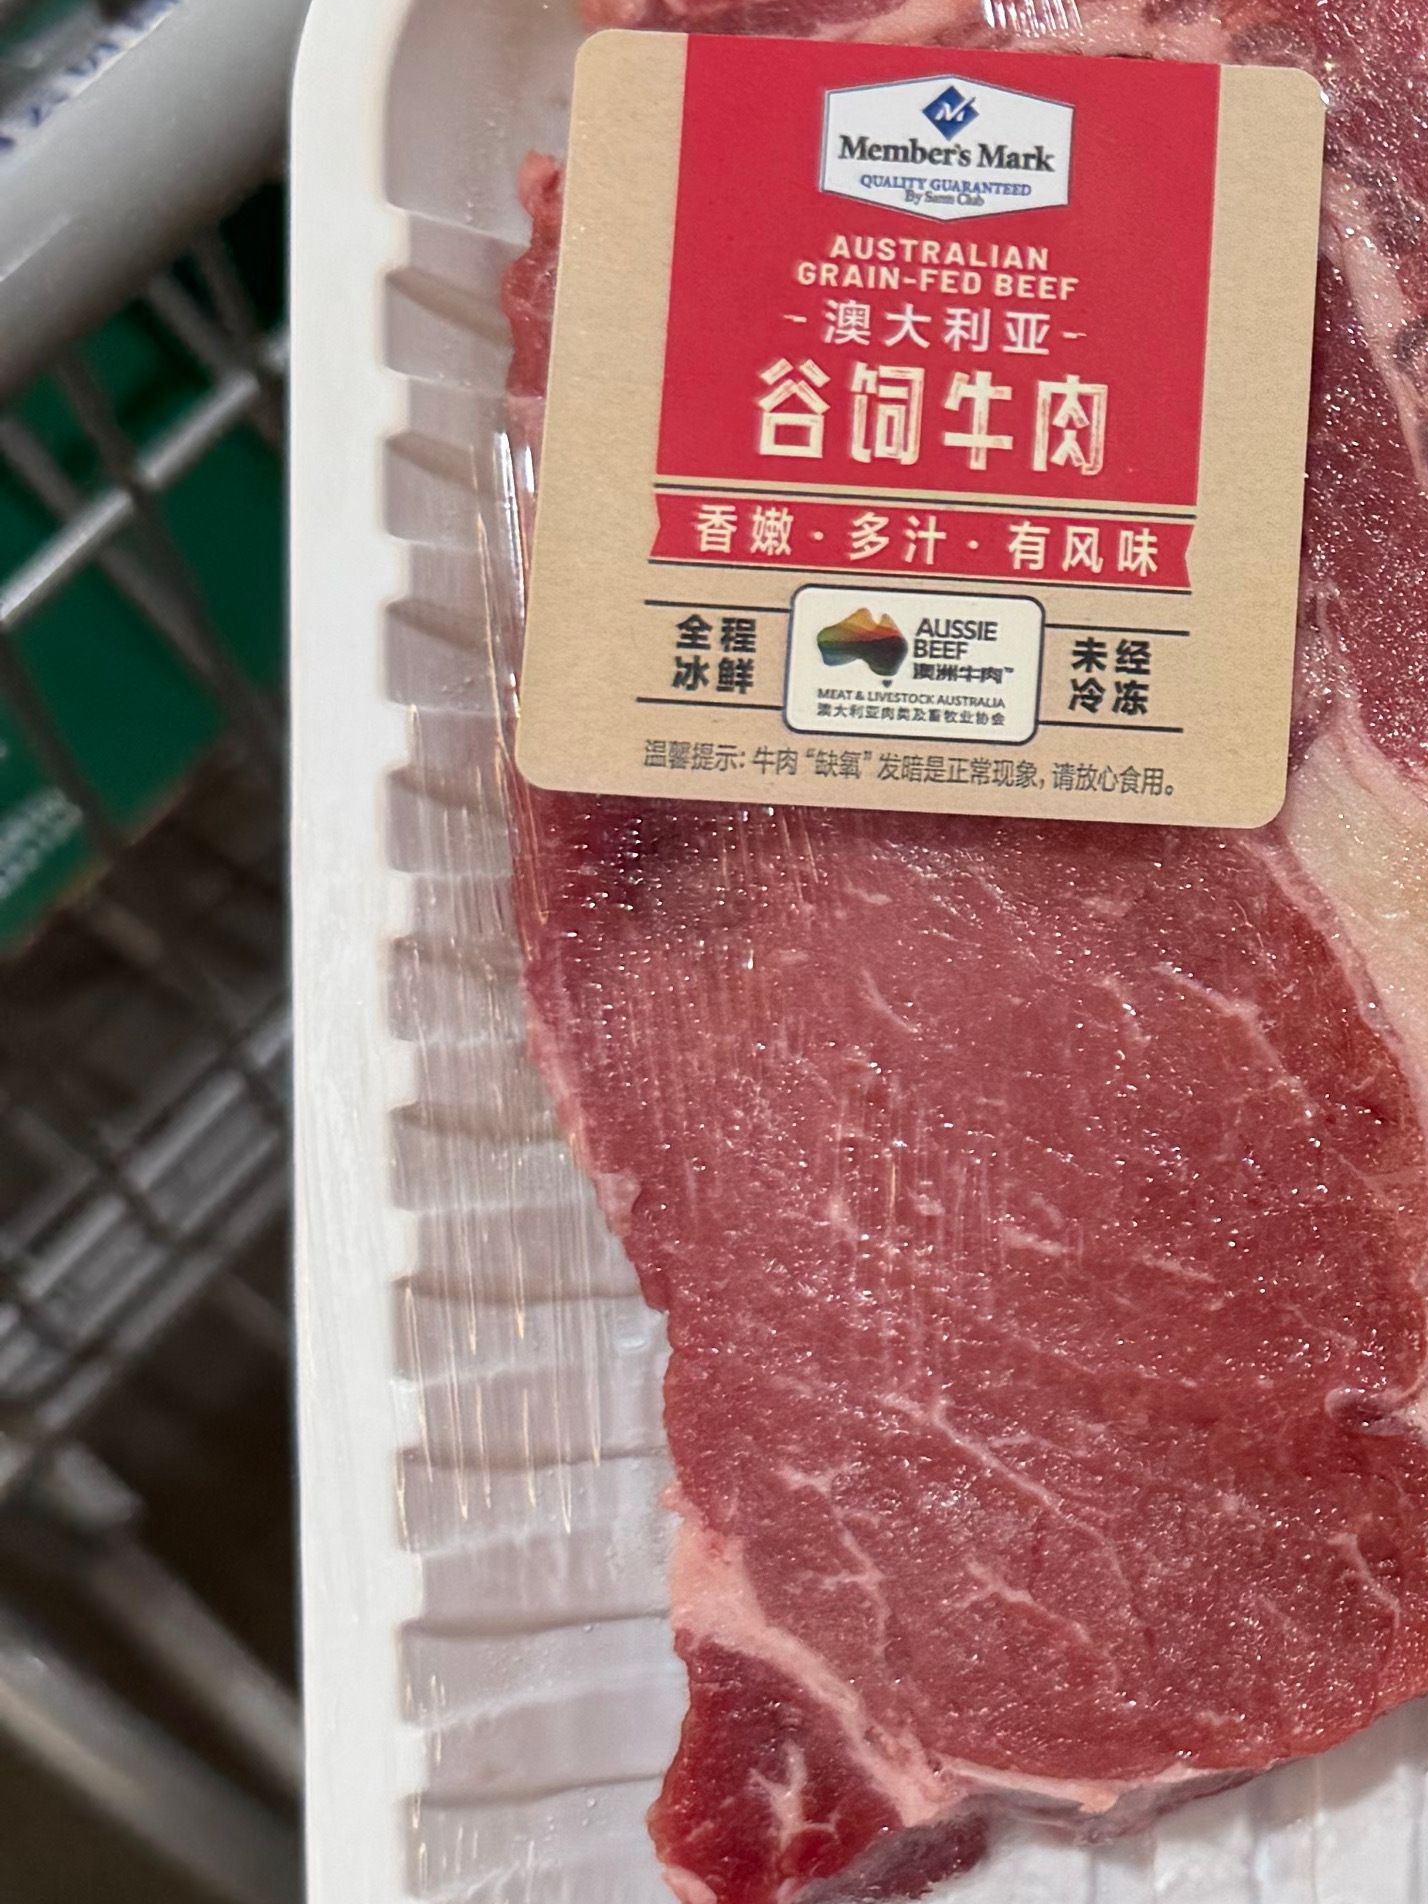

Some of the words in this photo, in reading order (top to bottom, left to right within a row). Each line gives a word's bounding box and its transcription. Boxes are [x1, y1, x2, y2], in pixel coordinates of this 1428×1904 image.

[838, 134, 971, 168] Member's
[976, 142, 1056, 173] Mark
[860, 174, 926, 191] QUALITY
[929, 178, 1032, 196] GUARANTEED
[904, 188, 923, 205] By
[829, 234, 1049, 271] AUSTRALIAN
[797, 260, 983, 295] GRAIN-FED
[993, 272, 1080, 301] BEEF
[757, 357, 1109, 476] 谷饲牛肉
[674, 613, 758, 654] 全程
[915, 617, 999, 642] AUSSIE
[911, 638, 970, 661] BEEF
[1070, 636, 1153, 676] 未经
[671, 654, 756, 695] 冰鲜
[815, 702, 1006, 726] 澳大利亚肉类及畜牧业协会
[816, 687, 853, 702] MEAT
[854, 689, 865, 702] &
[866, 690, 936, 706] LIVESTOCK
[936, 694, 1006, 709] AUSTRALIA
[1067, 677, 1150, 716] 冷冻
